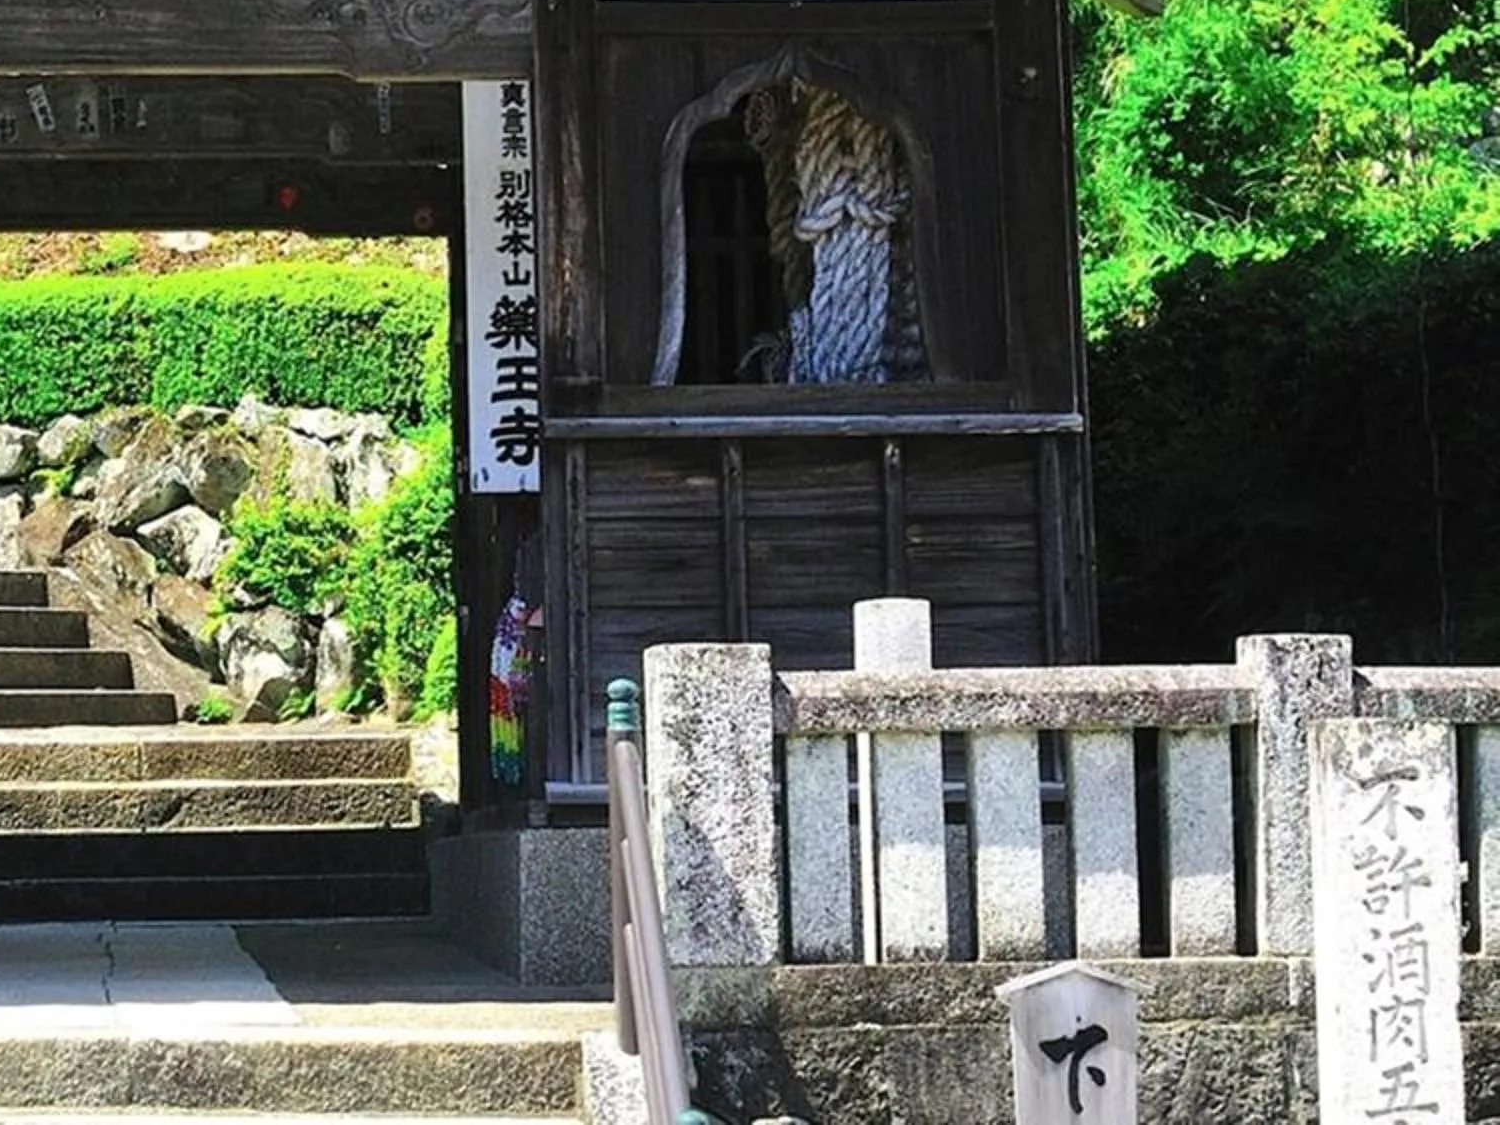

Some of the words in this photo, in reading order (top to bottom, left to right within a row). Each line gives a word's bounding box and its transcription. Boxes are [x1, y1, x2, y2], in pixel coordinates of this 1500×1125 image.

[1346, 759, 1440, 1125] 不許酒肉五
